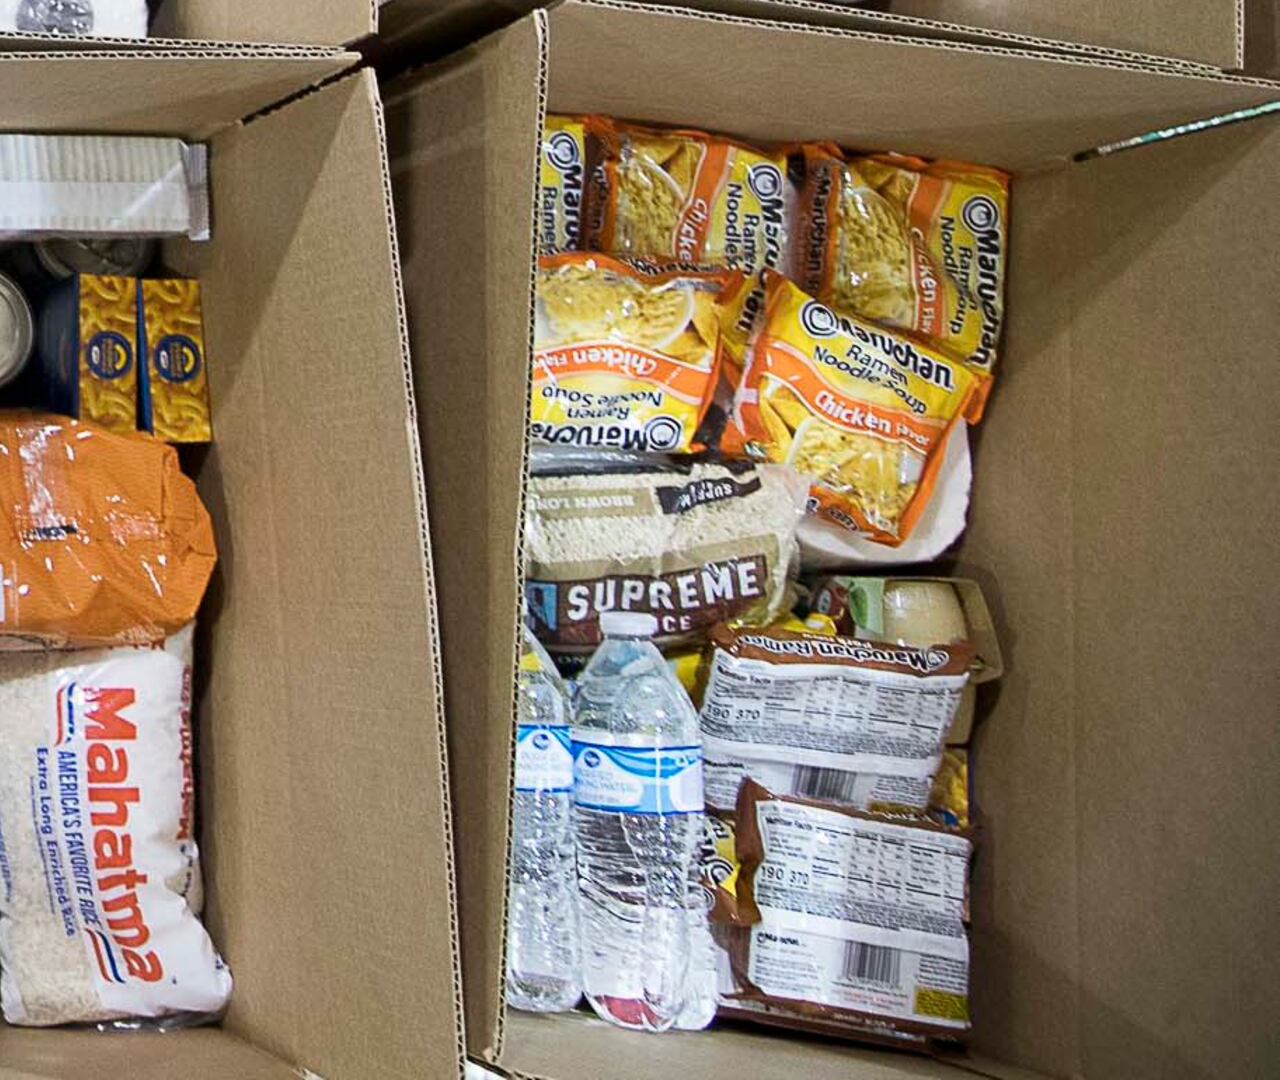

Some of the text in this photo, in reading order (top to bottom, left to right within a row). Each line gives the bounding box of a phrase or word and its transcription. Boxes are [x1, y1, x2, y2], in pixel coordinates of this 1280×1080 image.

[809, 177, 830, 271] Maruchan
[911, 226, 937, 302] Chicken
[968, 229, 1000, 365] Maruchan
[574, 347, 657, 376] Chicken
[814, 346, 927, 414] Noodle Soup
[840, 318, 954, 391] Maruchan
[846, 345, 908, 386] Ramen
[542, 386, 596, 406] Soup
[567, 406, 630, 420] Ramen
[815, 388, 892, 435] Chicken
[566, 562, 763, 620] SUPREME
[742, 634, 930, 671] Maruchan Ramen
[736, 709, 760, 721] 370
[36, 746, 76, 937] Extra Long Enriched Rice
[58, 750, 103, 934] AMERICA'S FAVORITE RICE
[83, 685, 164, 985] Mahatma
[760, 864, 810, 886] 190 370
